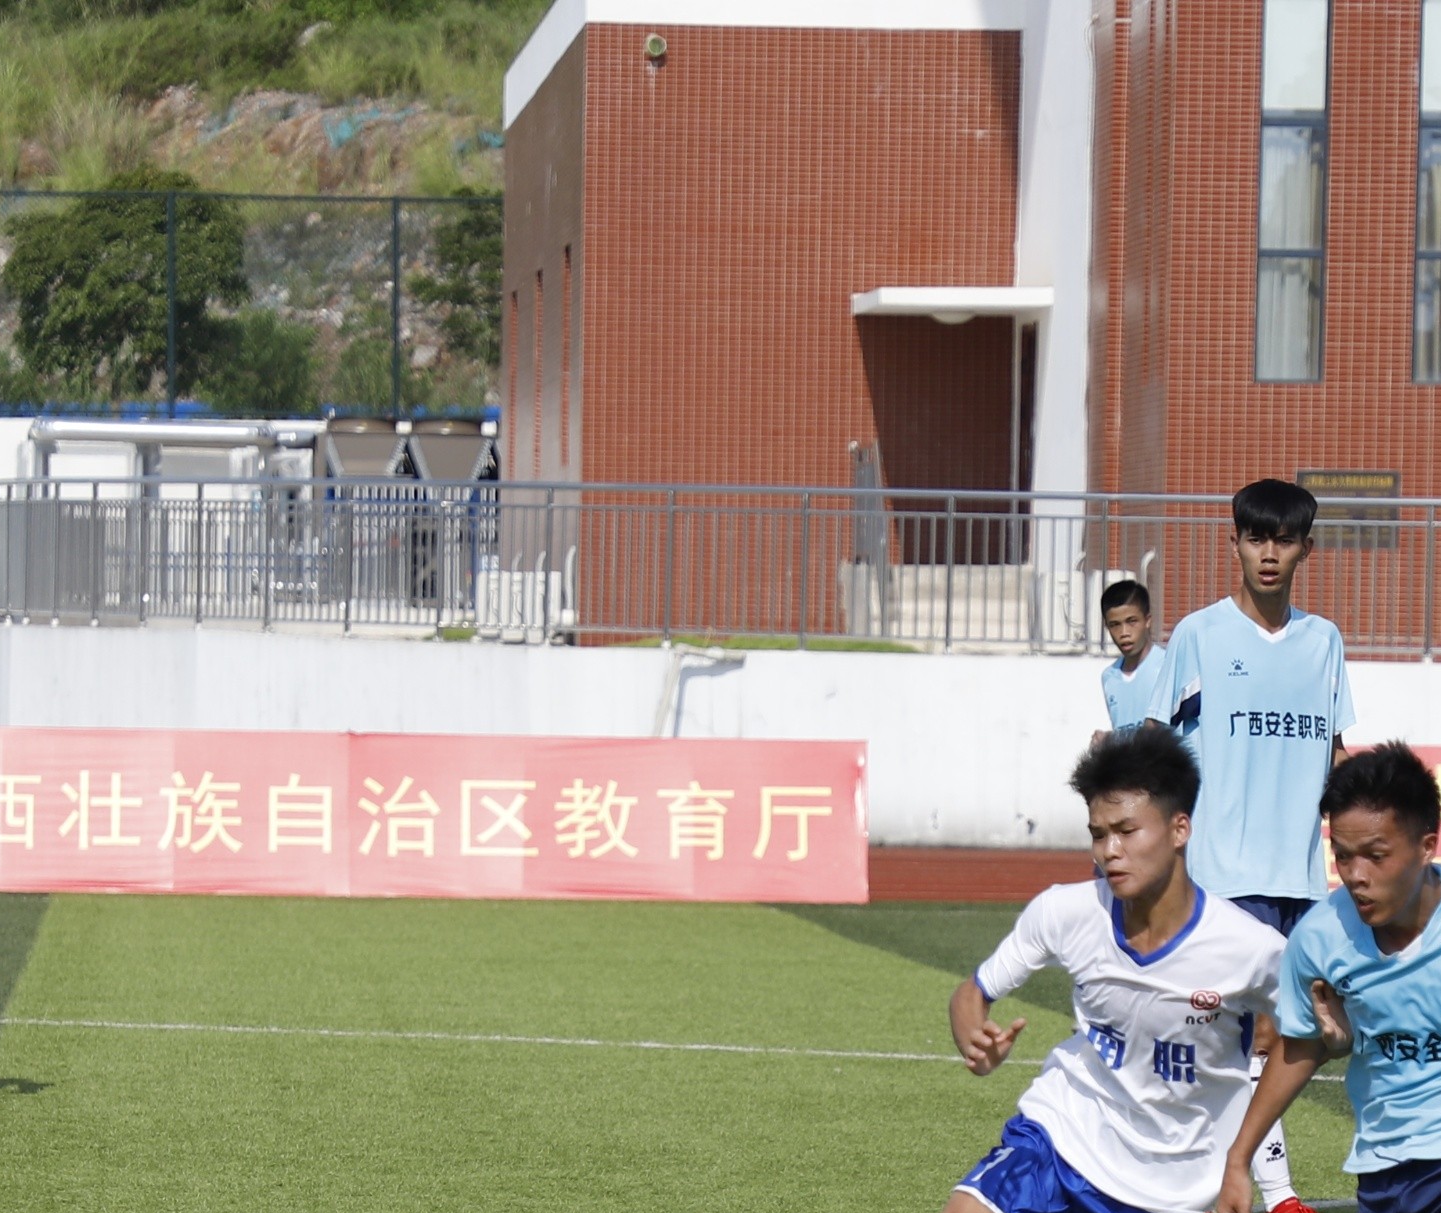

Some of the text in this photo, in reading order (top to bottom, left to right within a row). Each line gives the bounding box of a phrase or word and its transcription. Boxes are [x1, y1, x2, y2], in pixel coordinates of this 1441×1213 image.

[1229, 710, 1328, 741] 广西安全职院
